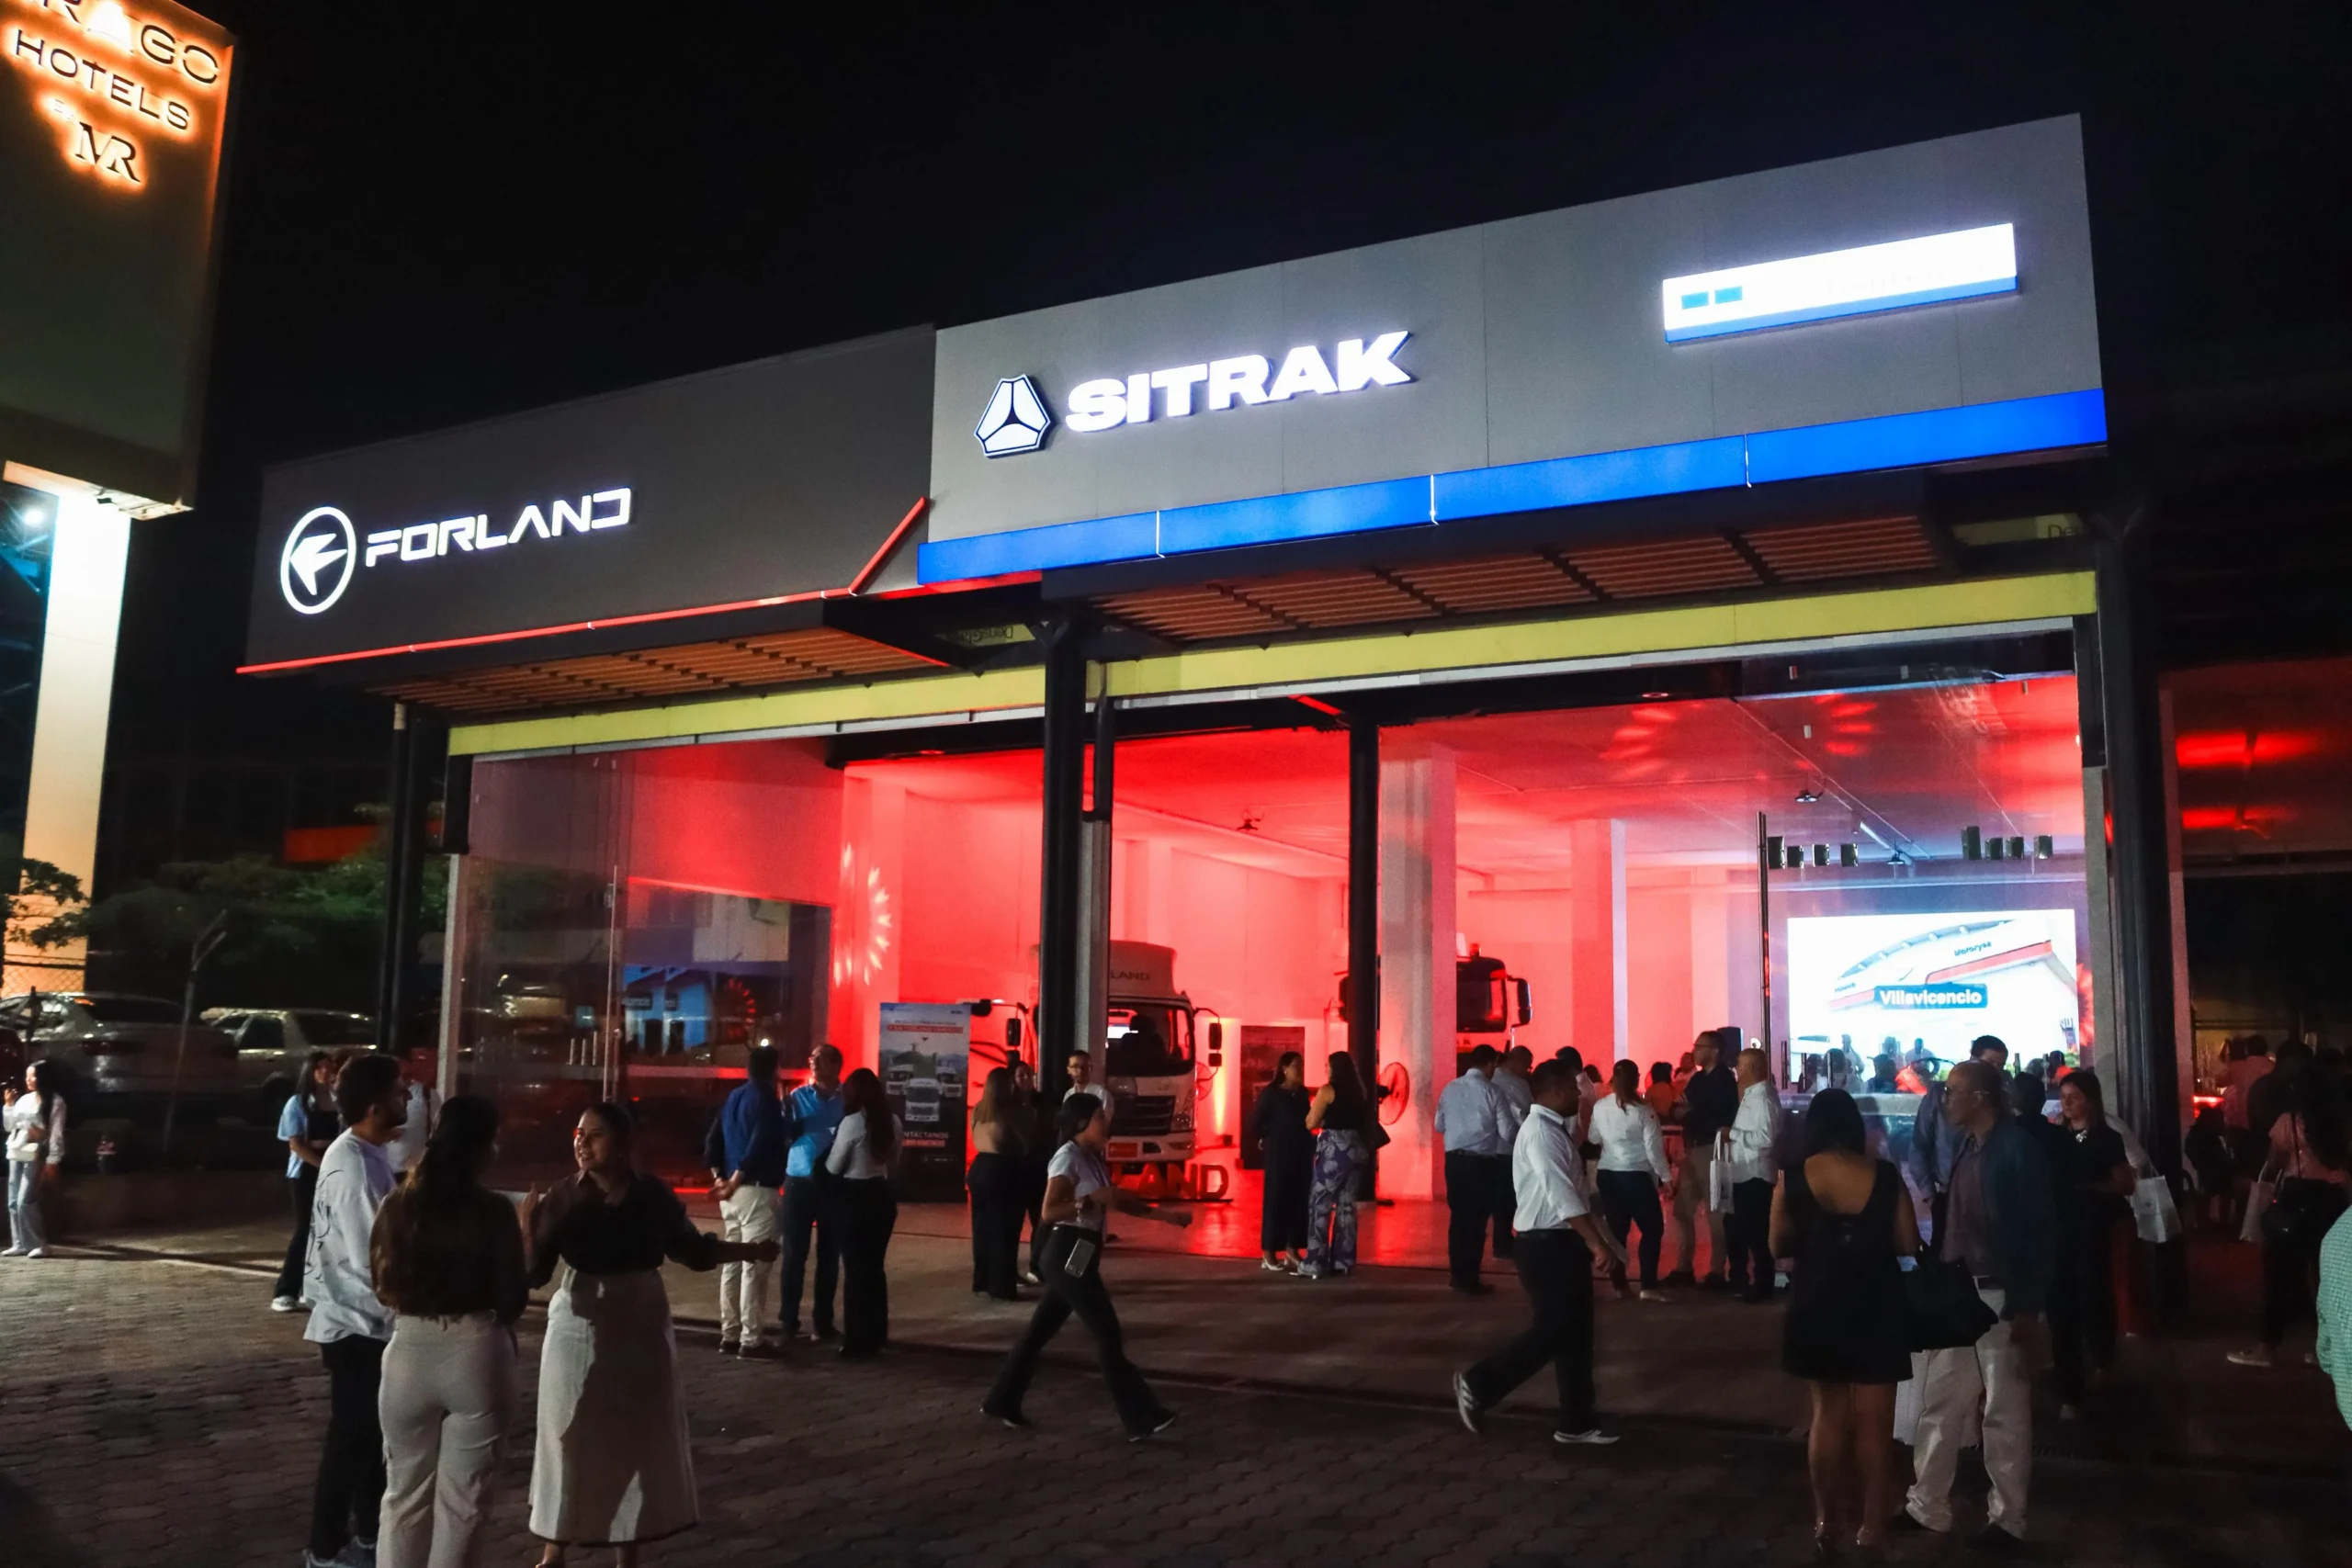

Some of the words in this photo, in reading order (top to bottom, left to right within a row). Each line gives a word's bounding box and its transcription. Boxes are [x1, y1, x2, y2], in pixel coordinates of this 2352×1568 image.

[16, 28, 190, 130] HOTELS
[1066, 331, 1412, 433] SITRAK
[365, 487, 631, 568] FORLAND
[1879, 989, 1982, 1006] Villavicencio
